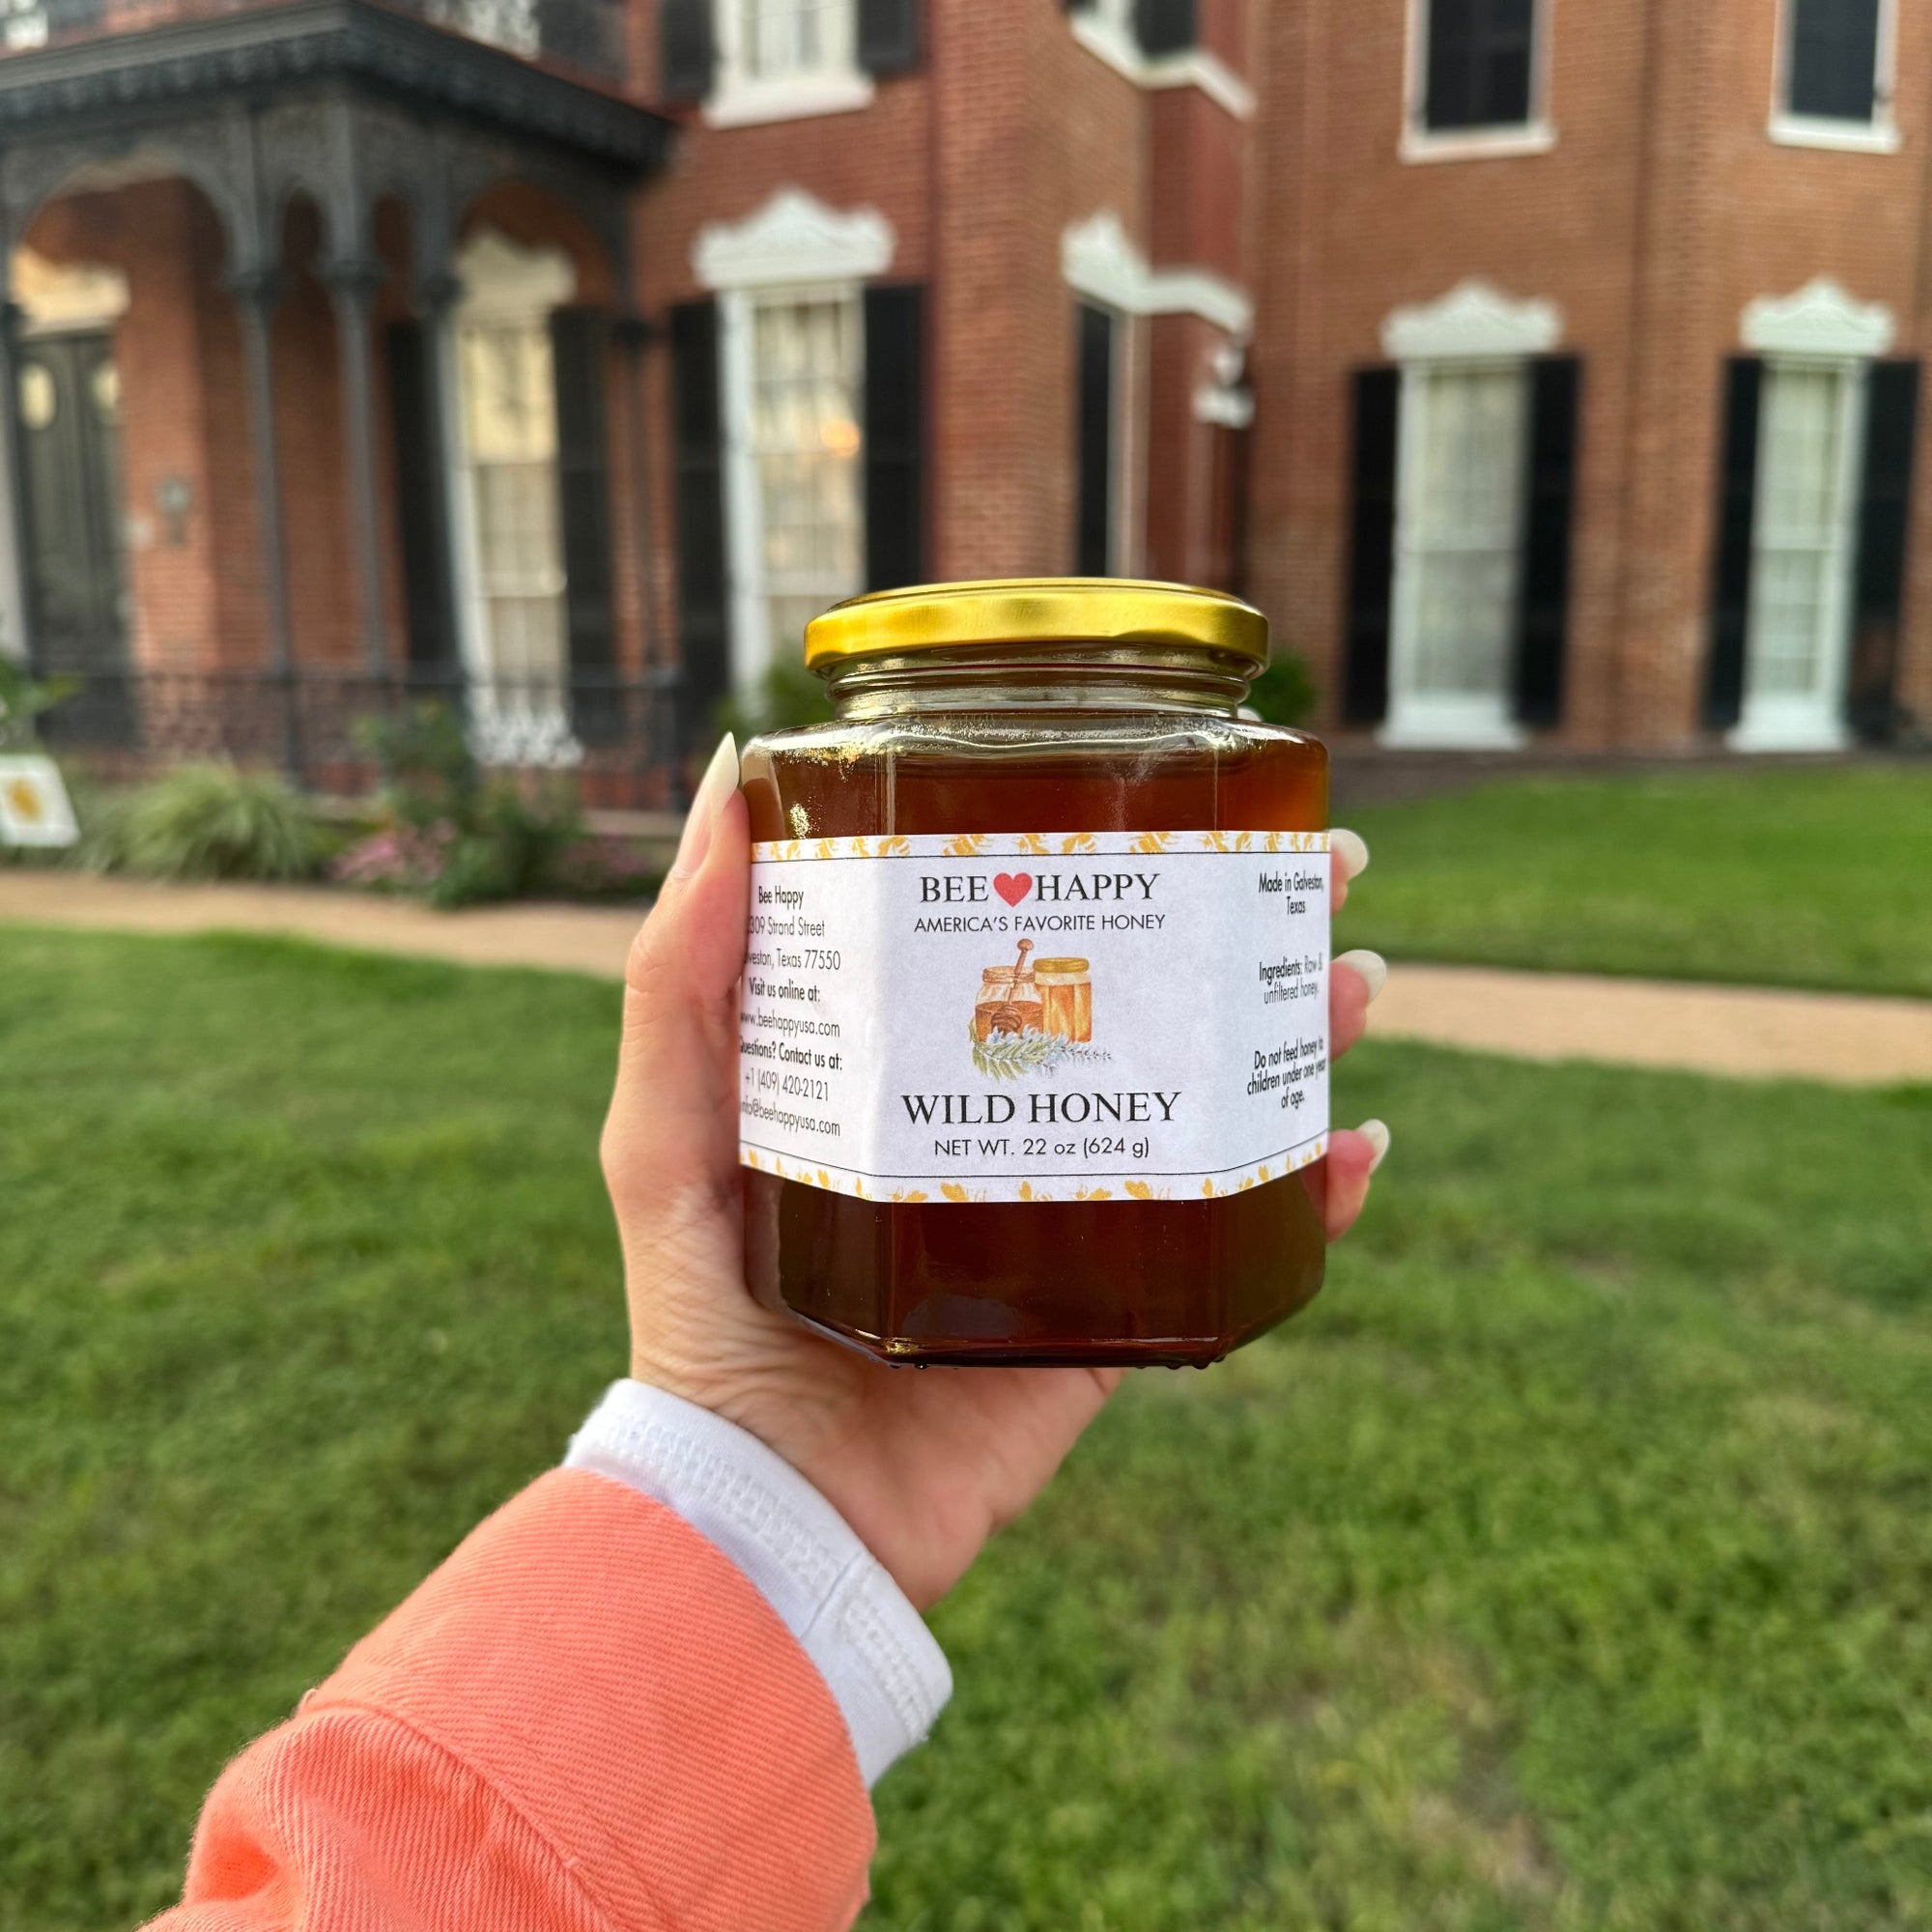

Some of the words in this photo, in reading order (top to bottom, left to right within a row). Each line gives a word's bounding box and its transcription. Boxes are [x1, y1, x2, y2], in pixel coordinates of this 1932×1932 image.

[920, 875, 989, 903] BEE
[1035, 872, 1159, 901] HAPPY
[1259, 870, 1283, 894] Made
[1284, 871, 1292, 892] in
[758, 885, 773, 904] Bee
[775, 885, 804, 910] Happy
[1286, 895, 1306, 916] Texas
[747, 915, 765, 935] 309
[767, 916, 796, 937] Strand
[798, 916, 825, 938] Street
[1014, 915, 1095, 931] FAVORITE
[1101, 914, 1165, 930] HONEY
[776, 948, 803, 969] Texas
[804, 949, 841, 971] 77550
[1259, 955, 1303, 985] Ingredients:
[749, 977, 766, 997] Visit
[767, 985, 777, 999] us
[779, 978, 806, 1002] online
[808, 985, 821, 1003] at:
[1264, 977, 1299, 1005] unfiltered
[779, 1041, 811, 1066] Contact
[814, 1054, 826, 1068] us
[828, 1052, 843, 1071] at:
[1254, 1050, 1266, 1069] Do
[1268, 1046, 1282, 1066] not
[1283, 1037, 1298, 1063] feed
[757, 1067, 781, 1097] (409)
[782, 1074, 830, 1102] 420-2121
[1247, 1069, 1280, 1095] children
[1282, 1061, 1303, 1086] under
[900, 1094, 1016, 1125] WILD
[1028, 1092, 1182, 1123] HONEY
[1281, 1086, 1290, 1109] of
[1290, 1089, 1305, 1110] age.
[934, 1138, 972, 1156] NET
[977, 1138, 1015, 1156] WT.
[1023, 1138, 1047, 1155] 22
[1054, 1142, 1076, 1155] oz
[1083, 1136, 1126, 1159] (624
[1132, 1136, 1151, 1159] g)
